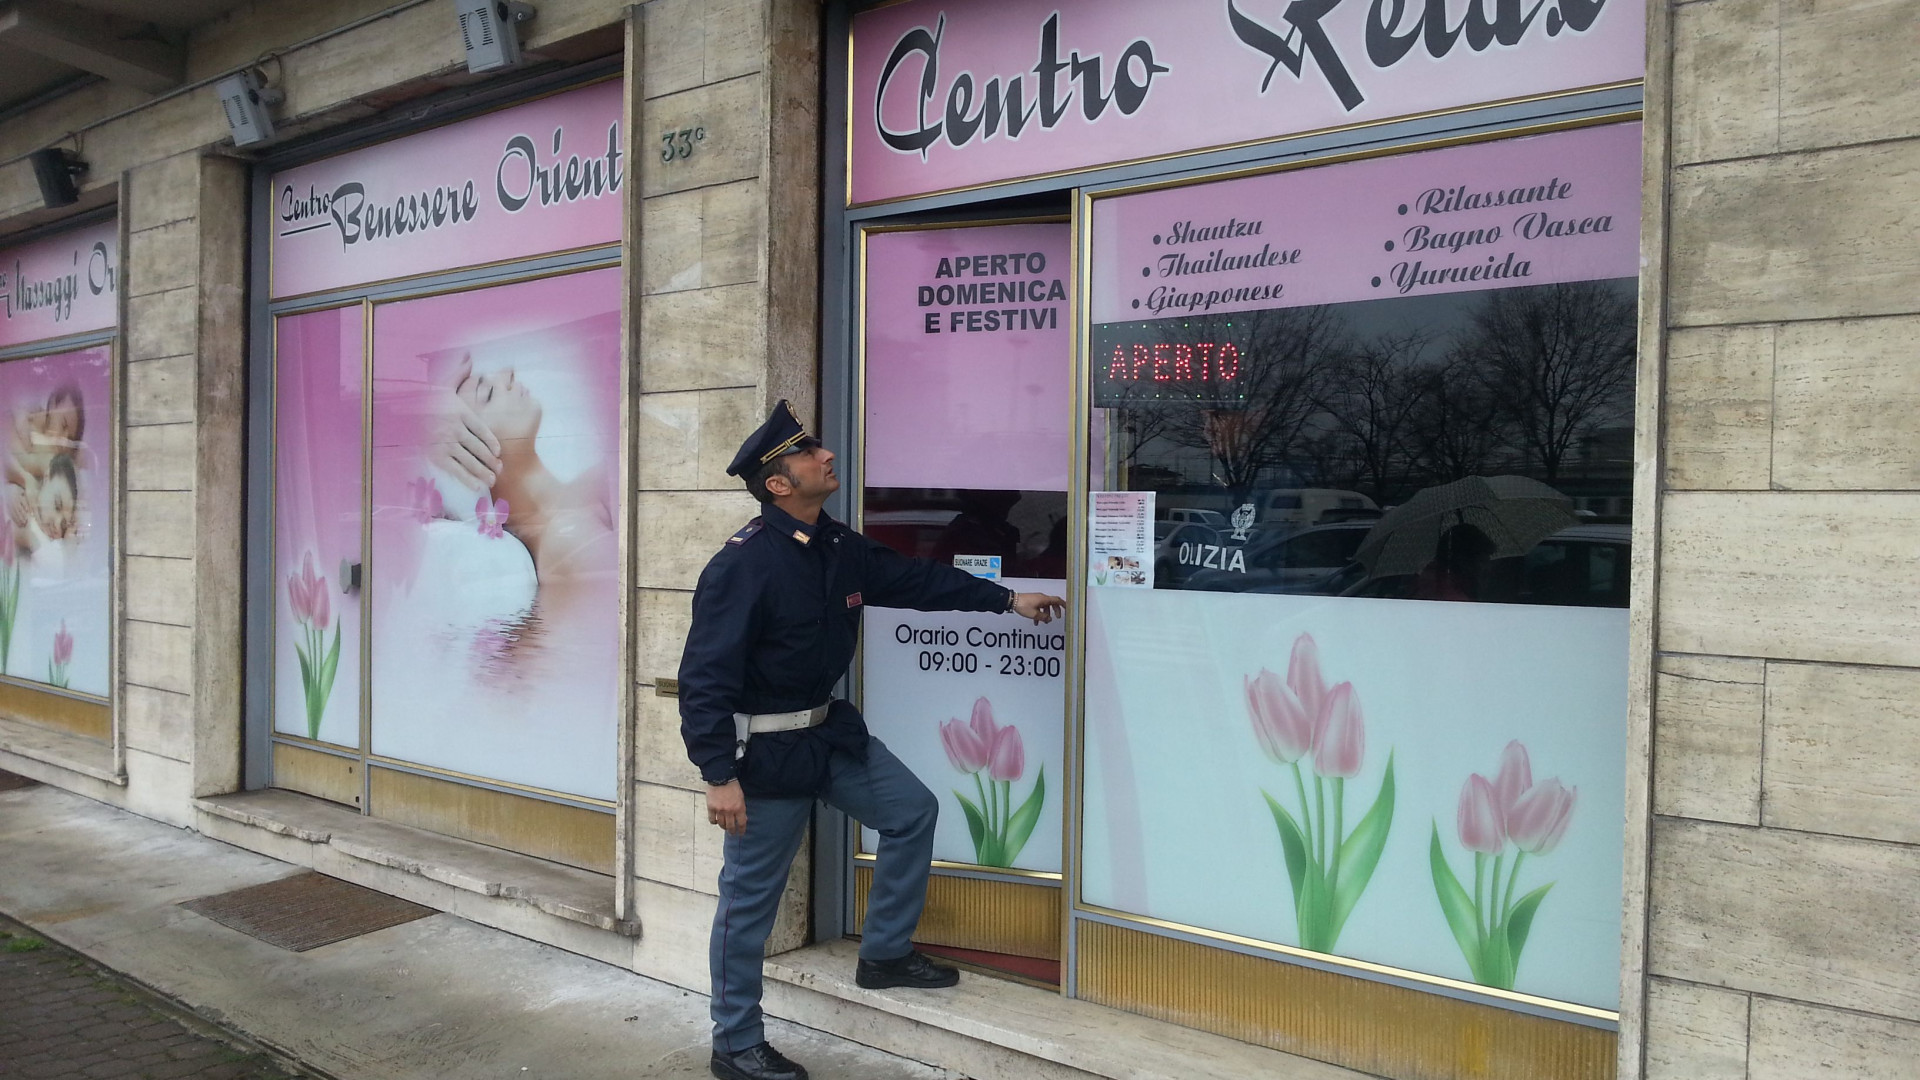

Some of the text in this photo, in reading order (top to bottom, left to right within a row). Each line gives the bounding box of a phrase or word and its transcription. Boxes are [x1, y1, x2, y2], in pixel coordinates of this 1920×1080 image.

[876, 11, 1170, 158] Centro
[1415, 177, 1573, 216] Rilassante
[280, 183, 334, 222] Centro
[331, 182, 479, 254] Benessere
[1166, 218, 1264, 246] Shautzu
[1403, 212, 1613, 253] Bagno Vasca
[935, 252, 1046, 279] APERTO
[1157, 243, 1303, 278] Thailandese
[1390, 252, 1533, 294] Yurueida
[918, 279, 1067, 307] DOMENICA
[1145, 283, 1285, 316] Giapponese
[925, 307, 1057, 333] E FESTIVI
[1109, 342, 1239, 381] APERTO
[895, 624, 959, 646] Orario
[919, 651, 978, 673] 09:00
[1000, 655, 1060, 678] 23:00
